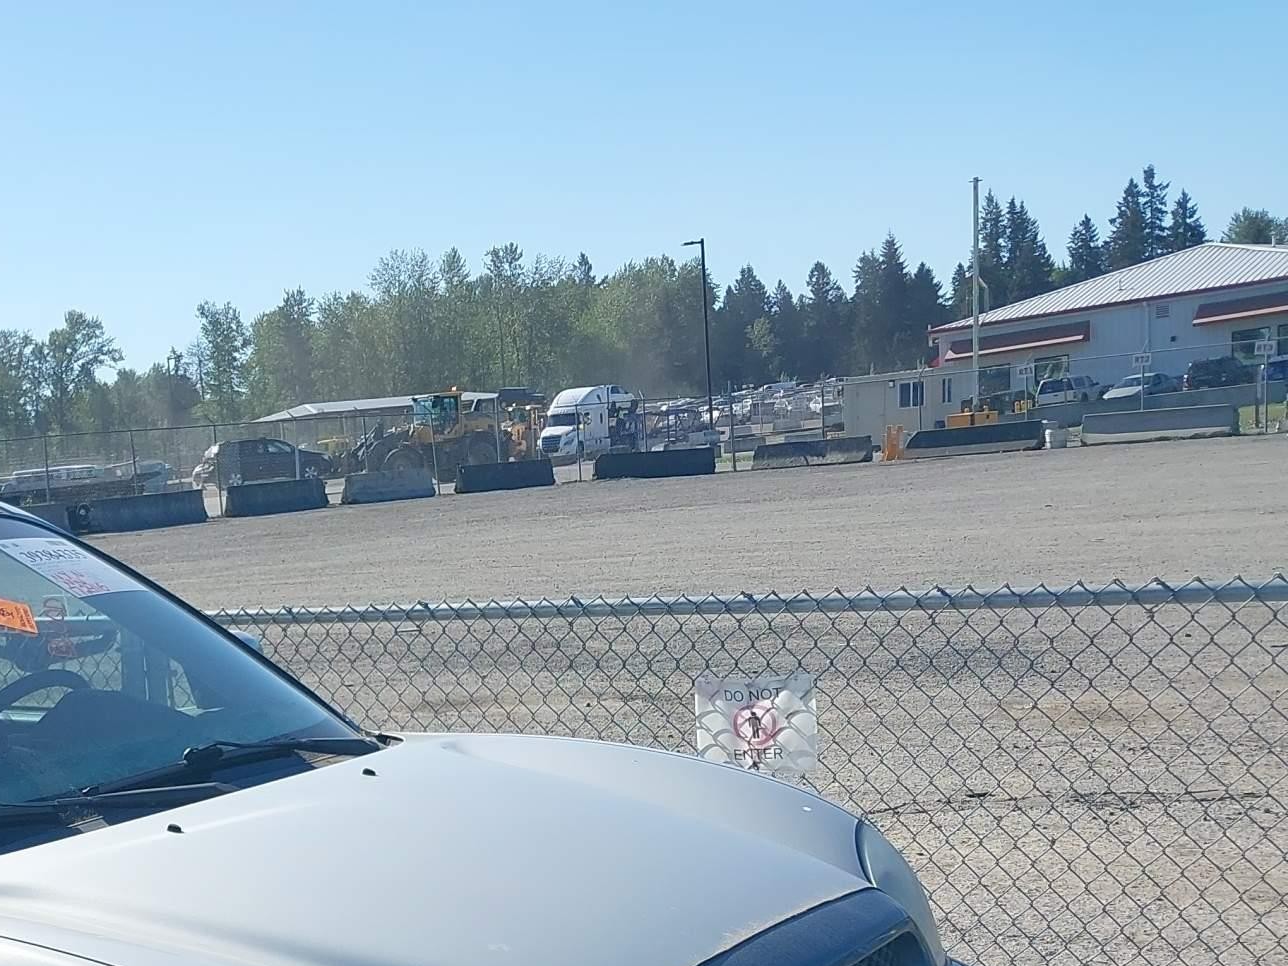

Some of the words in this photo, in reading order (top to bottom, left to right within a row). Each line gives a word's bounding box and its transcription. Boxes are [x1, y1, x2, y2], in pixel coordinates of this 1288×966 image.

[724, 689, 744, 702] DO
[748, 687, 782, 701] NOT
[733, 747, 784, 761] ENTER
